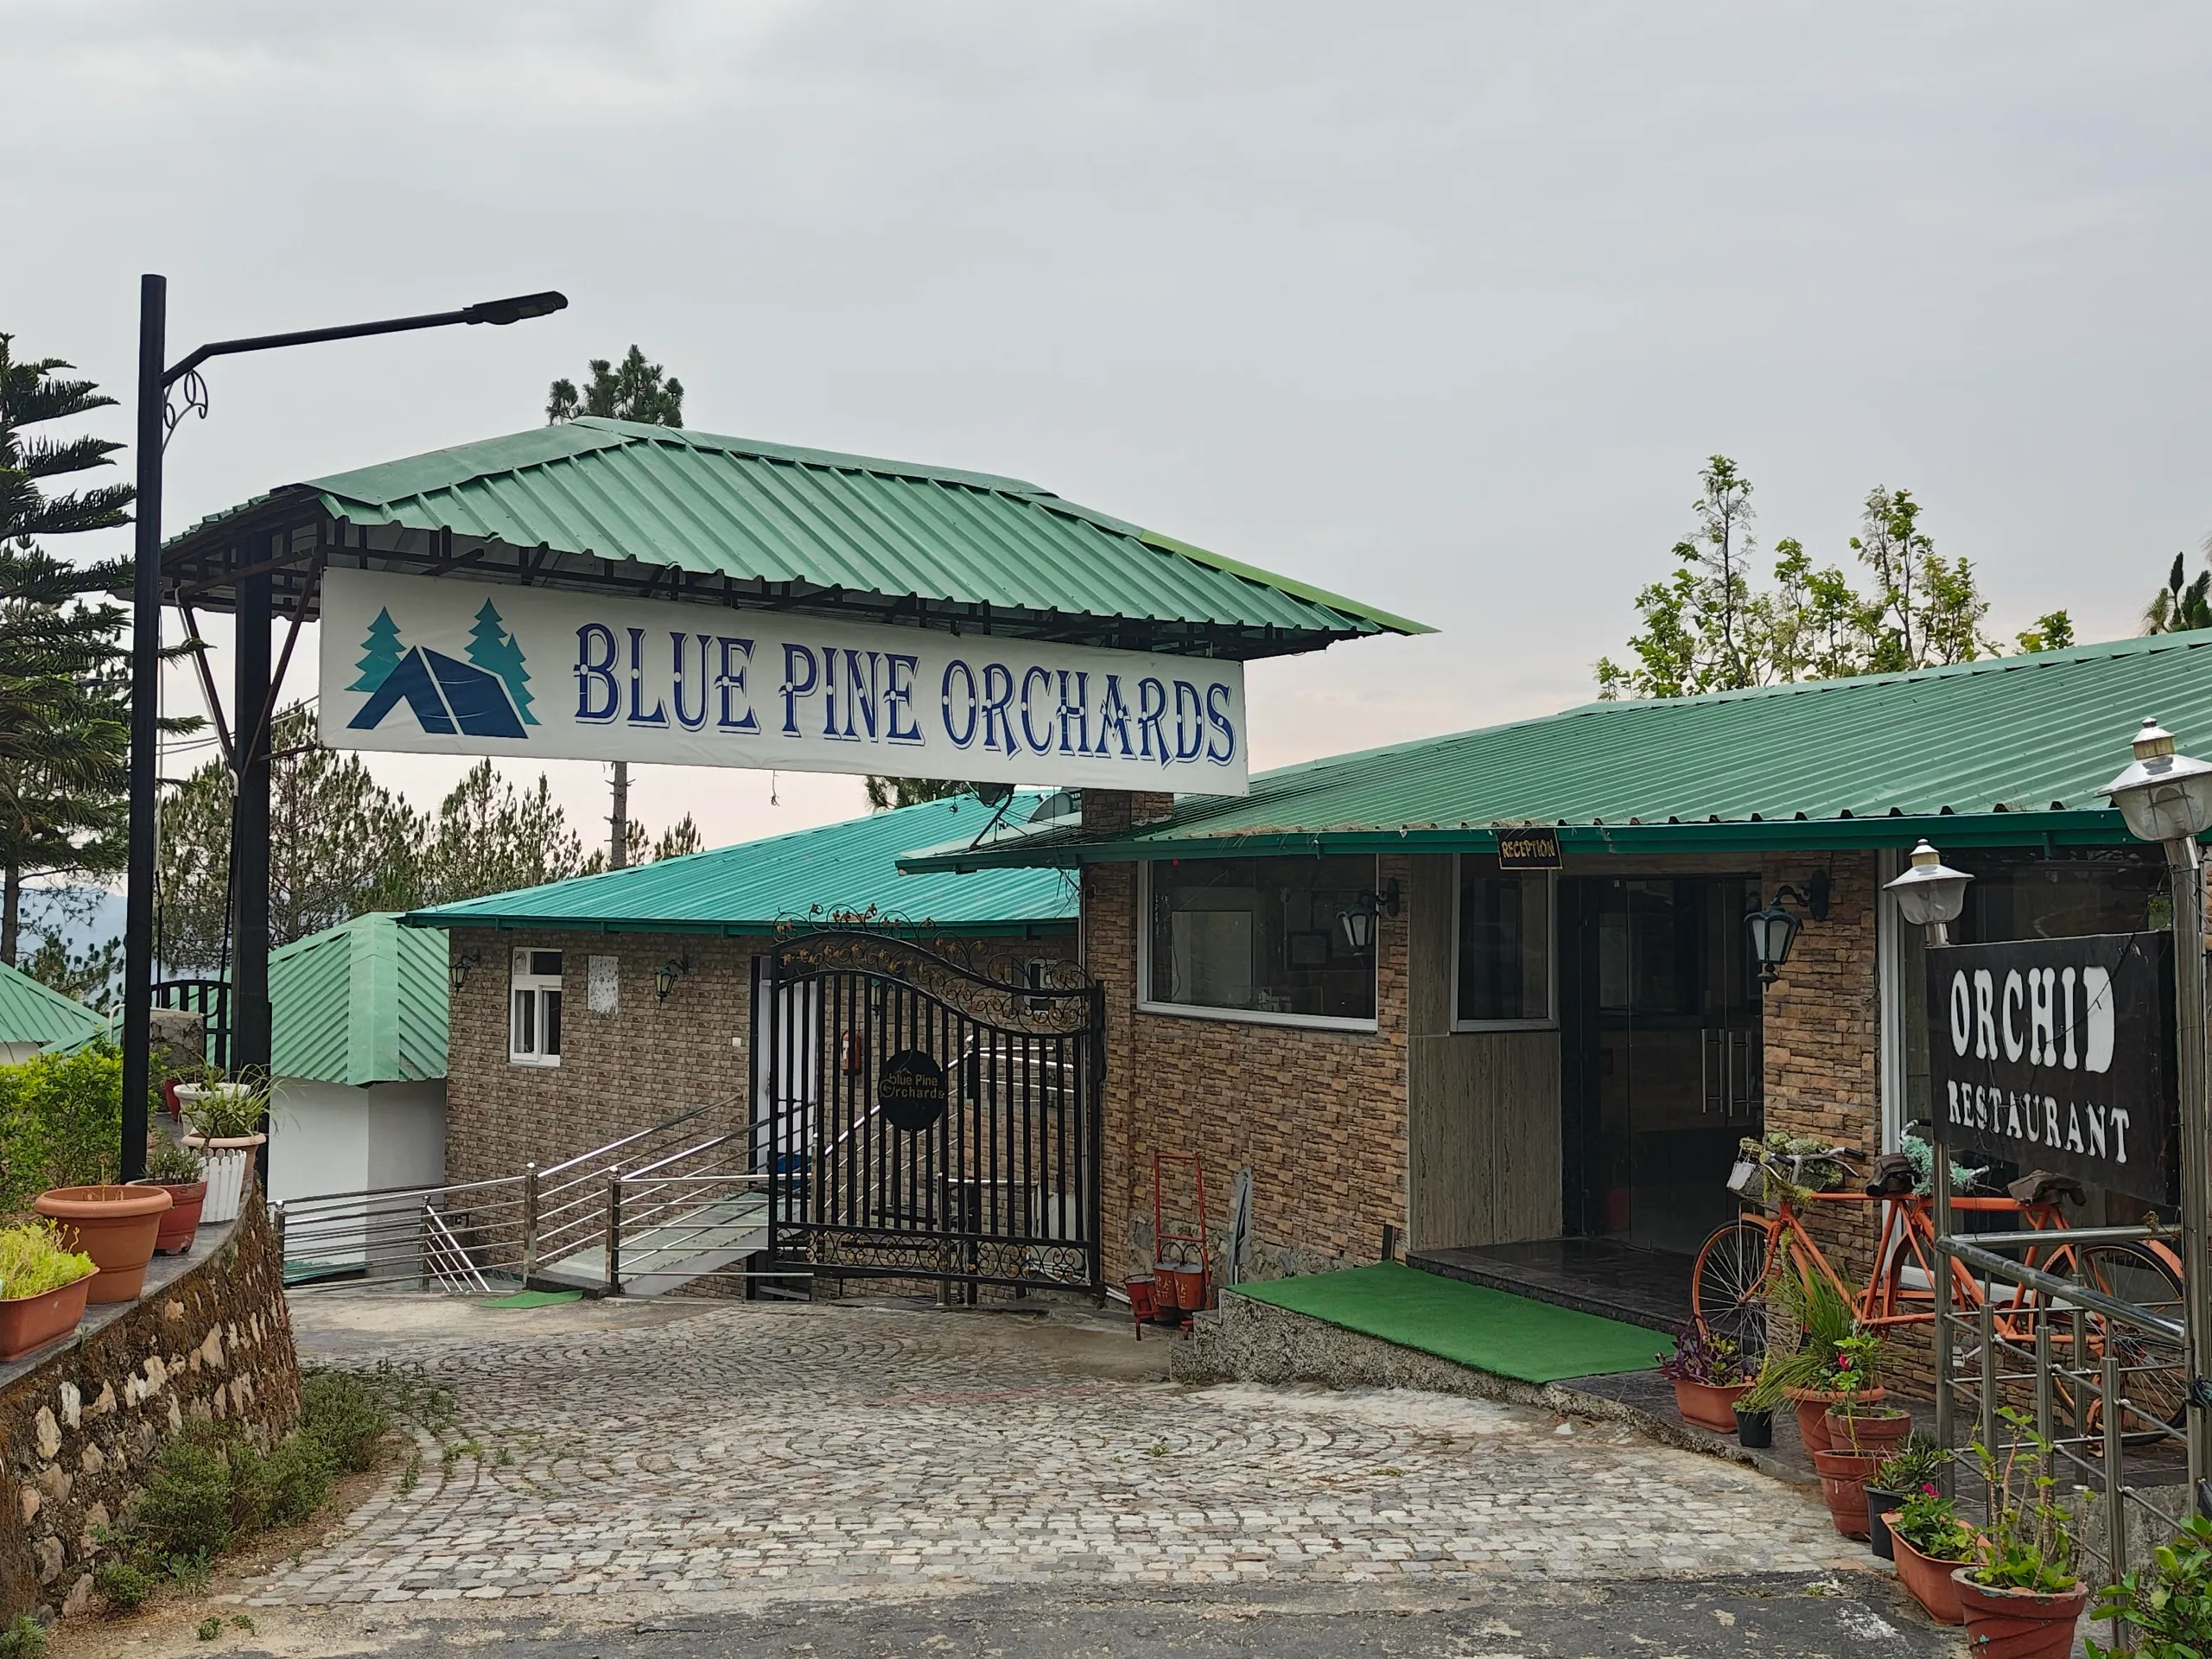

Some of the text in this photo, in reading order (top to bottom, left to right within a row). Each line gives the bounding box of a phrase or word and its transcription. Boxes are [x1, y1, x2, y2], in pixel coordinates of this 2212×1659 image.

[573, 622, 1237, 772] BLUE PINE ORCHARDS
[1501, 838, 1556, 858] RECEPTION
[1950, 965, 2115, 1074] ORCHID
[915, 1073, 938, 1087] Pine
[1947, 1079, 2131, 1165] RESTAURANT
